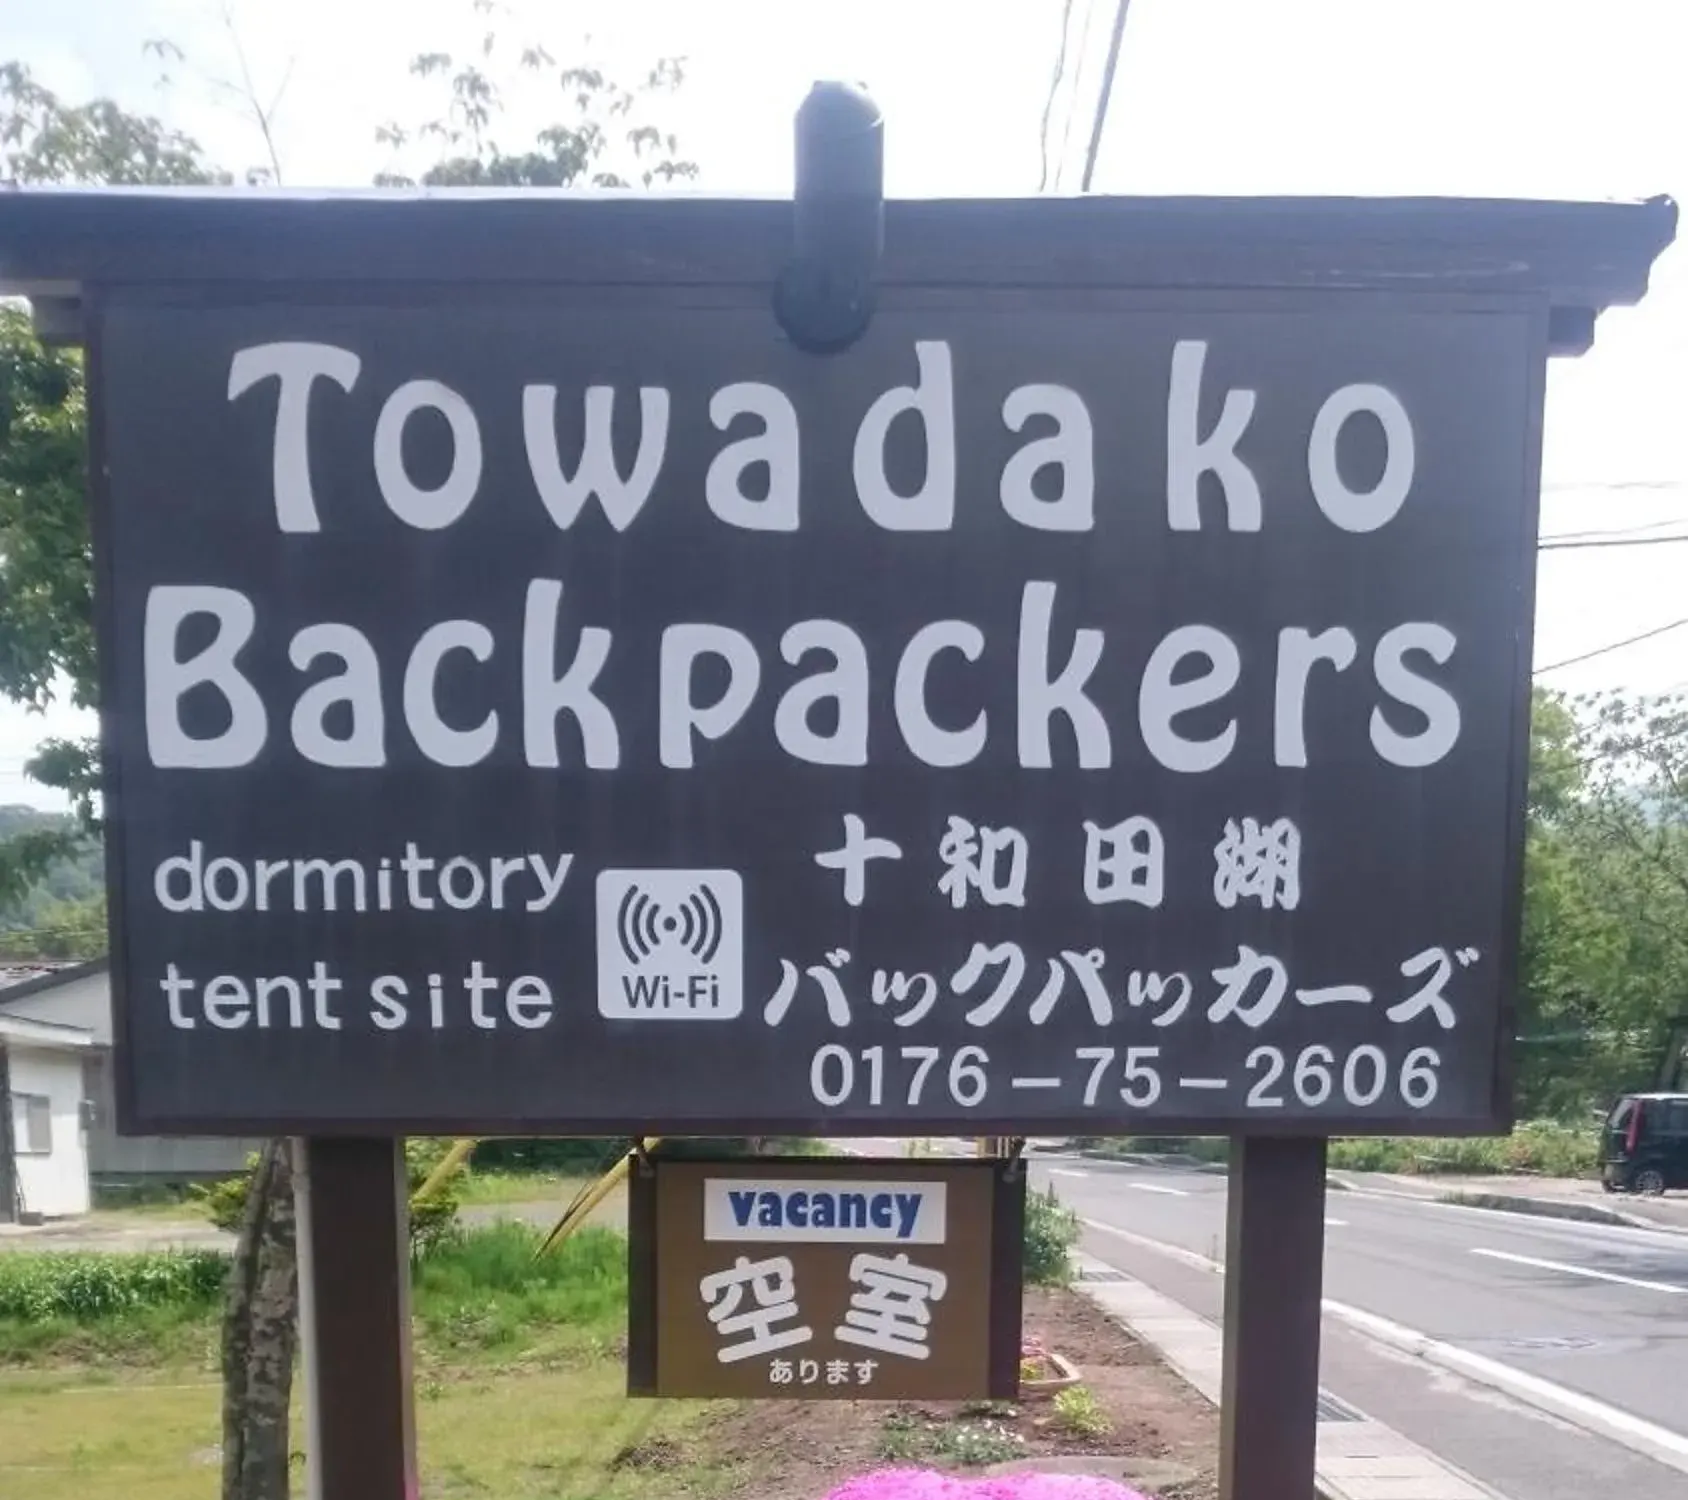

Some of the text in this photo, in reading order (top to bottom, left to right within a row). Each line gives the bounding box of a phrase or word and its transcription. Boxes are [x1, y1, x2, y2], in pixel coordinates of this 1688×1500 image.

[228, 340, 1415, 532] Towadako
[145, 579, 1461, 772] Backpackers
[155, 840, 573, 911] dormitory
[815, 814, 1301, 909] 十和田湖
[160, 961, 553, 1029] tent site
[622, 975, 719, 1009] Wi-Fi
[764, 942, 1479, 1028] バックパッカーズ
[728, 1191, 923, 1238] vacancy
[700, 1254, 947, 1363] 空室
[769, 1359, 878, 1385] あります
